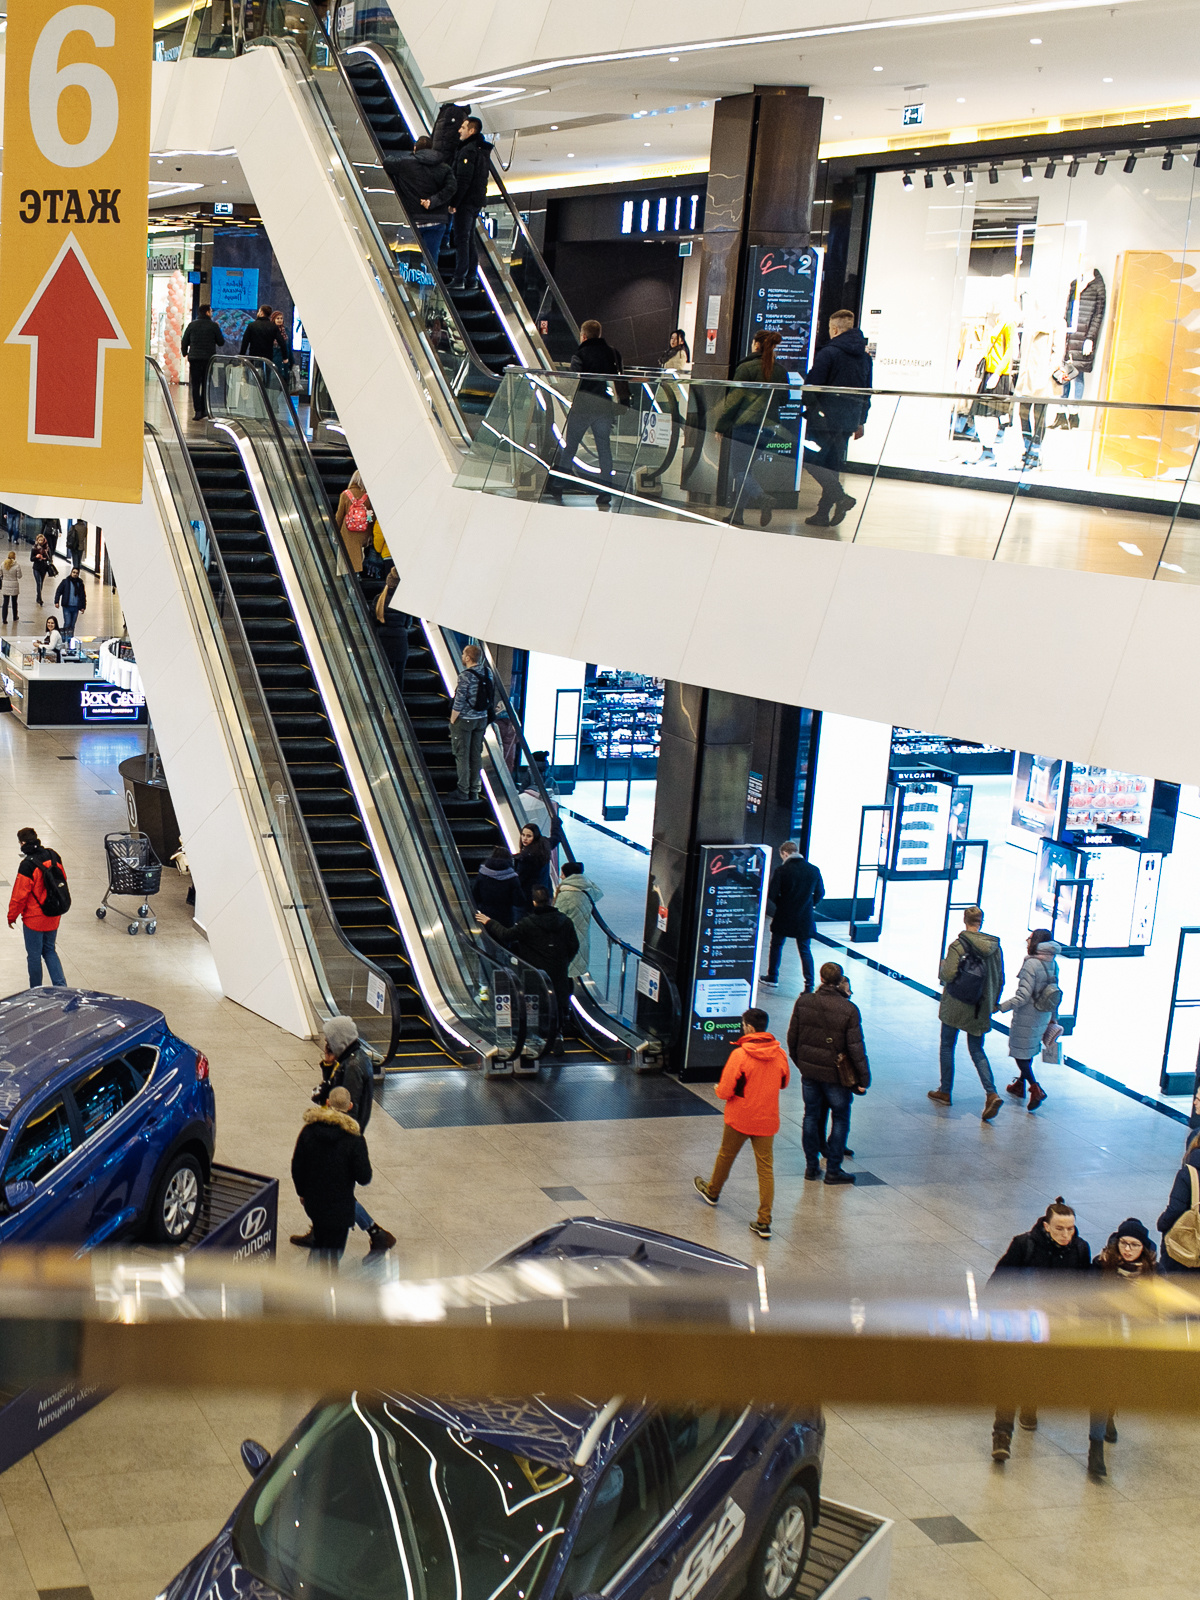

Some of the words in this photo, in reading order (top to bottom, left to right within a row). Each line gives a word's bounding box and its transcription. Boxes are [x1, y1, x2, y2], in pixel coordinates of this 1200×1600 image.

[29, 4, 119, 168] 6
[19, 189, 121, 224] ЭТАЖ
[798, 255, 812, 274] 2
[758, 288, 765, 297] 6
[756, 313, 763, 322] 5
[709, 886, 716, 894] 6
[706, 908, 714, 917] 5
[703, 945, 710, 953] 3
[701, 960, 708, 968] 2
[38, 1397, 76, 1431] Автоцентр
